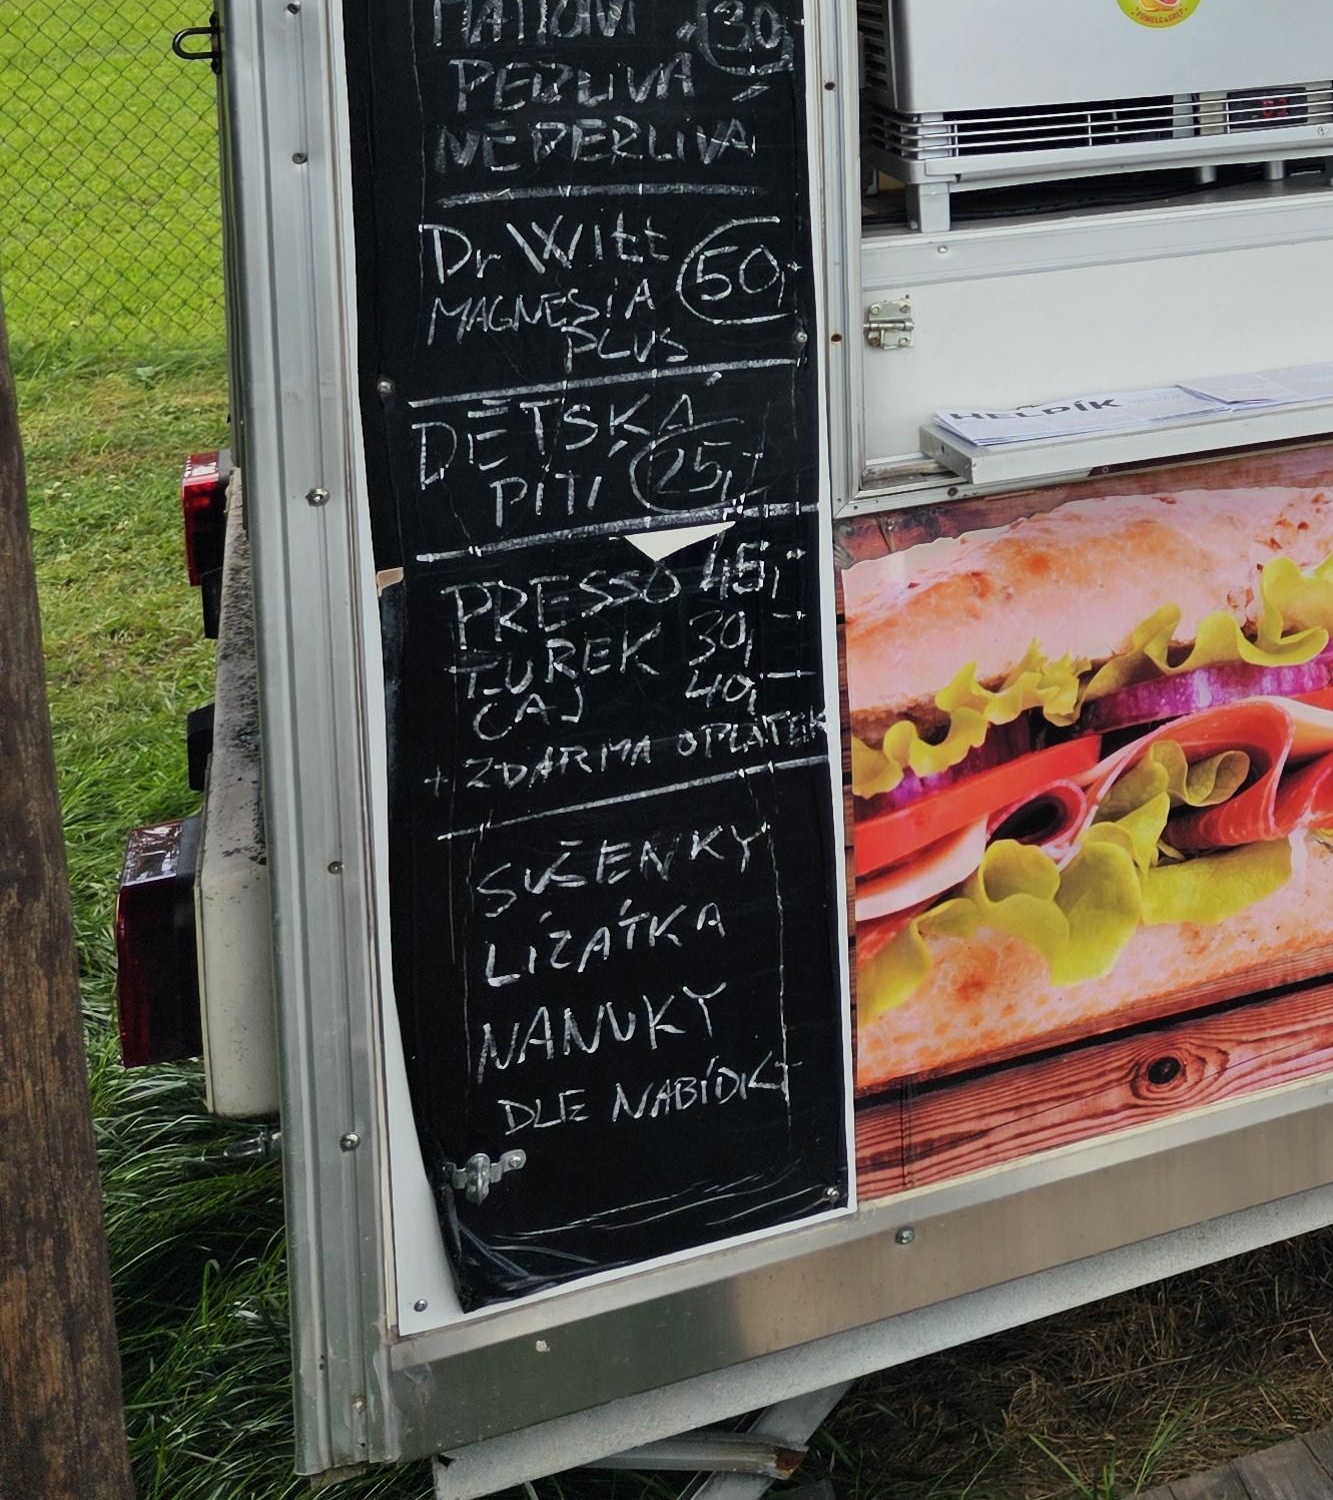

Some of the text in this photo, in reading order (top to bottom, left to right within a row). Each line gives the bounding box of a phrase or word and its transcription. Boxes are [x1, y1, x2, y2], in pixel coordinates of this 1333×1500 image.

[418, 222, 501, 283] Dr
[560, 325, 691, 373] PLUS
[440, 562, 681, 650] PRESSO
[466, 736, 652, 791] ZDARMA
[486, 898, 727, 987] LÍZÁTKA
[476, 981, 727, 1084] NANUKY
[503, 1088, 590, 1136] DLE
